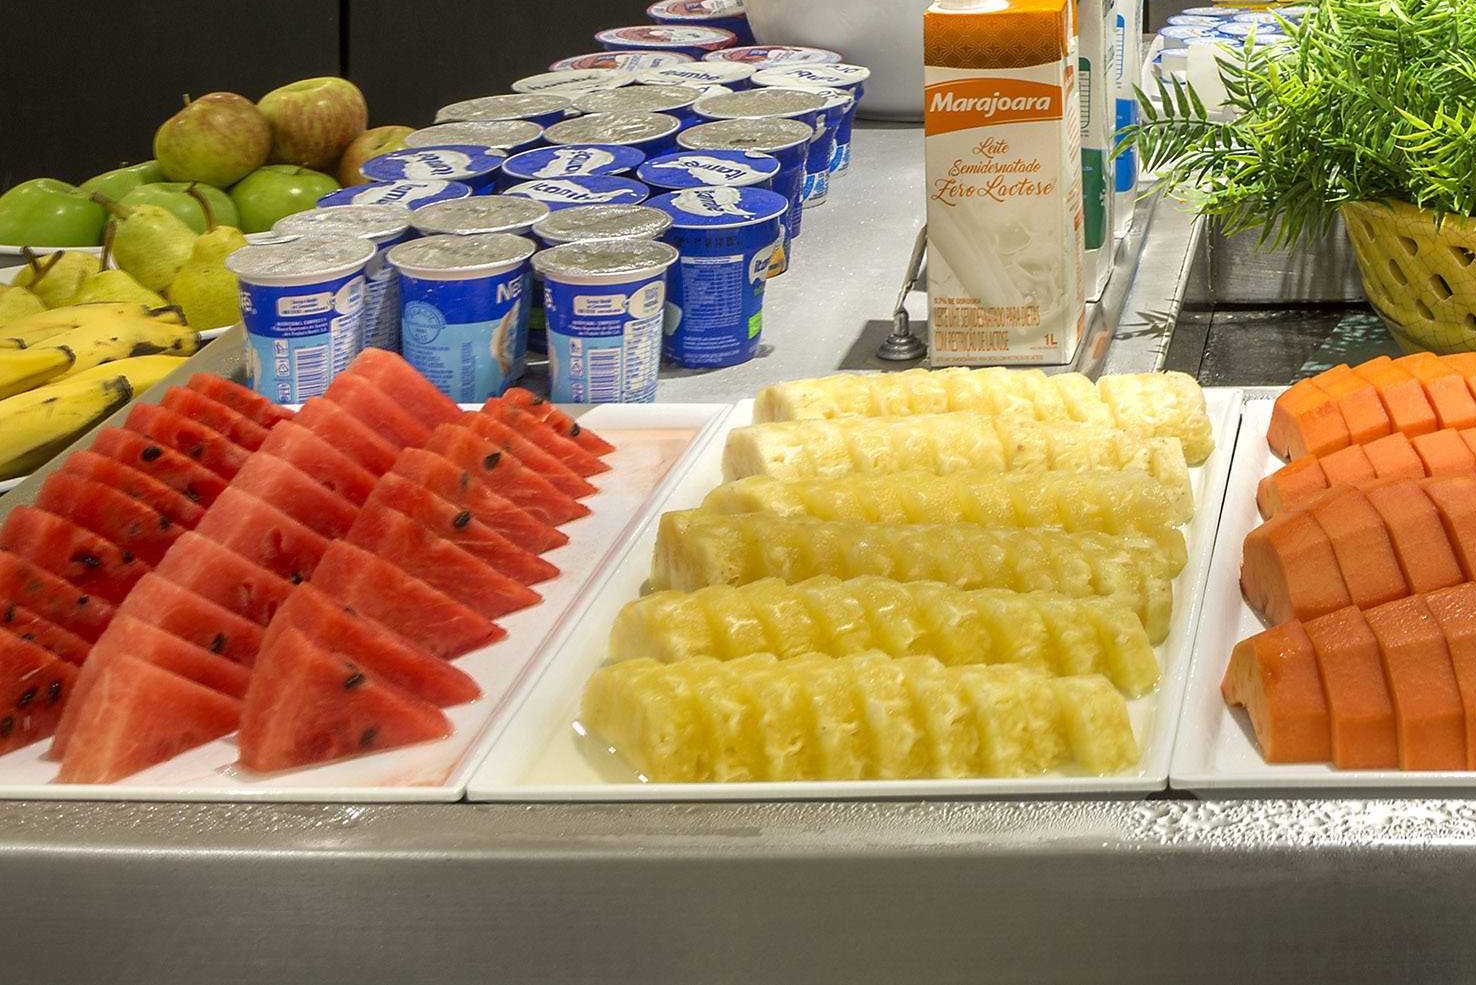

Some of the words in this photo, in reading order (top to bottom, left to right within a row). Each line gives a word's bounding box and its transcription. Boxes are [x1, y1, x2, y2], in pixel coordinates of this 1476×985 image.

[929, 91, 1051, 118] Marajoara
[972, 136, 1009, 159] Leite
[947, 158, 1041, 177] Semidesnatado
[930, 178, 977, 207] Zero
[977, 174, 1055, 203] Lactose
[1043, 333, 1058, 346] 1L
